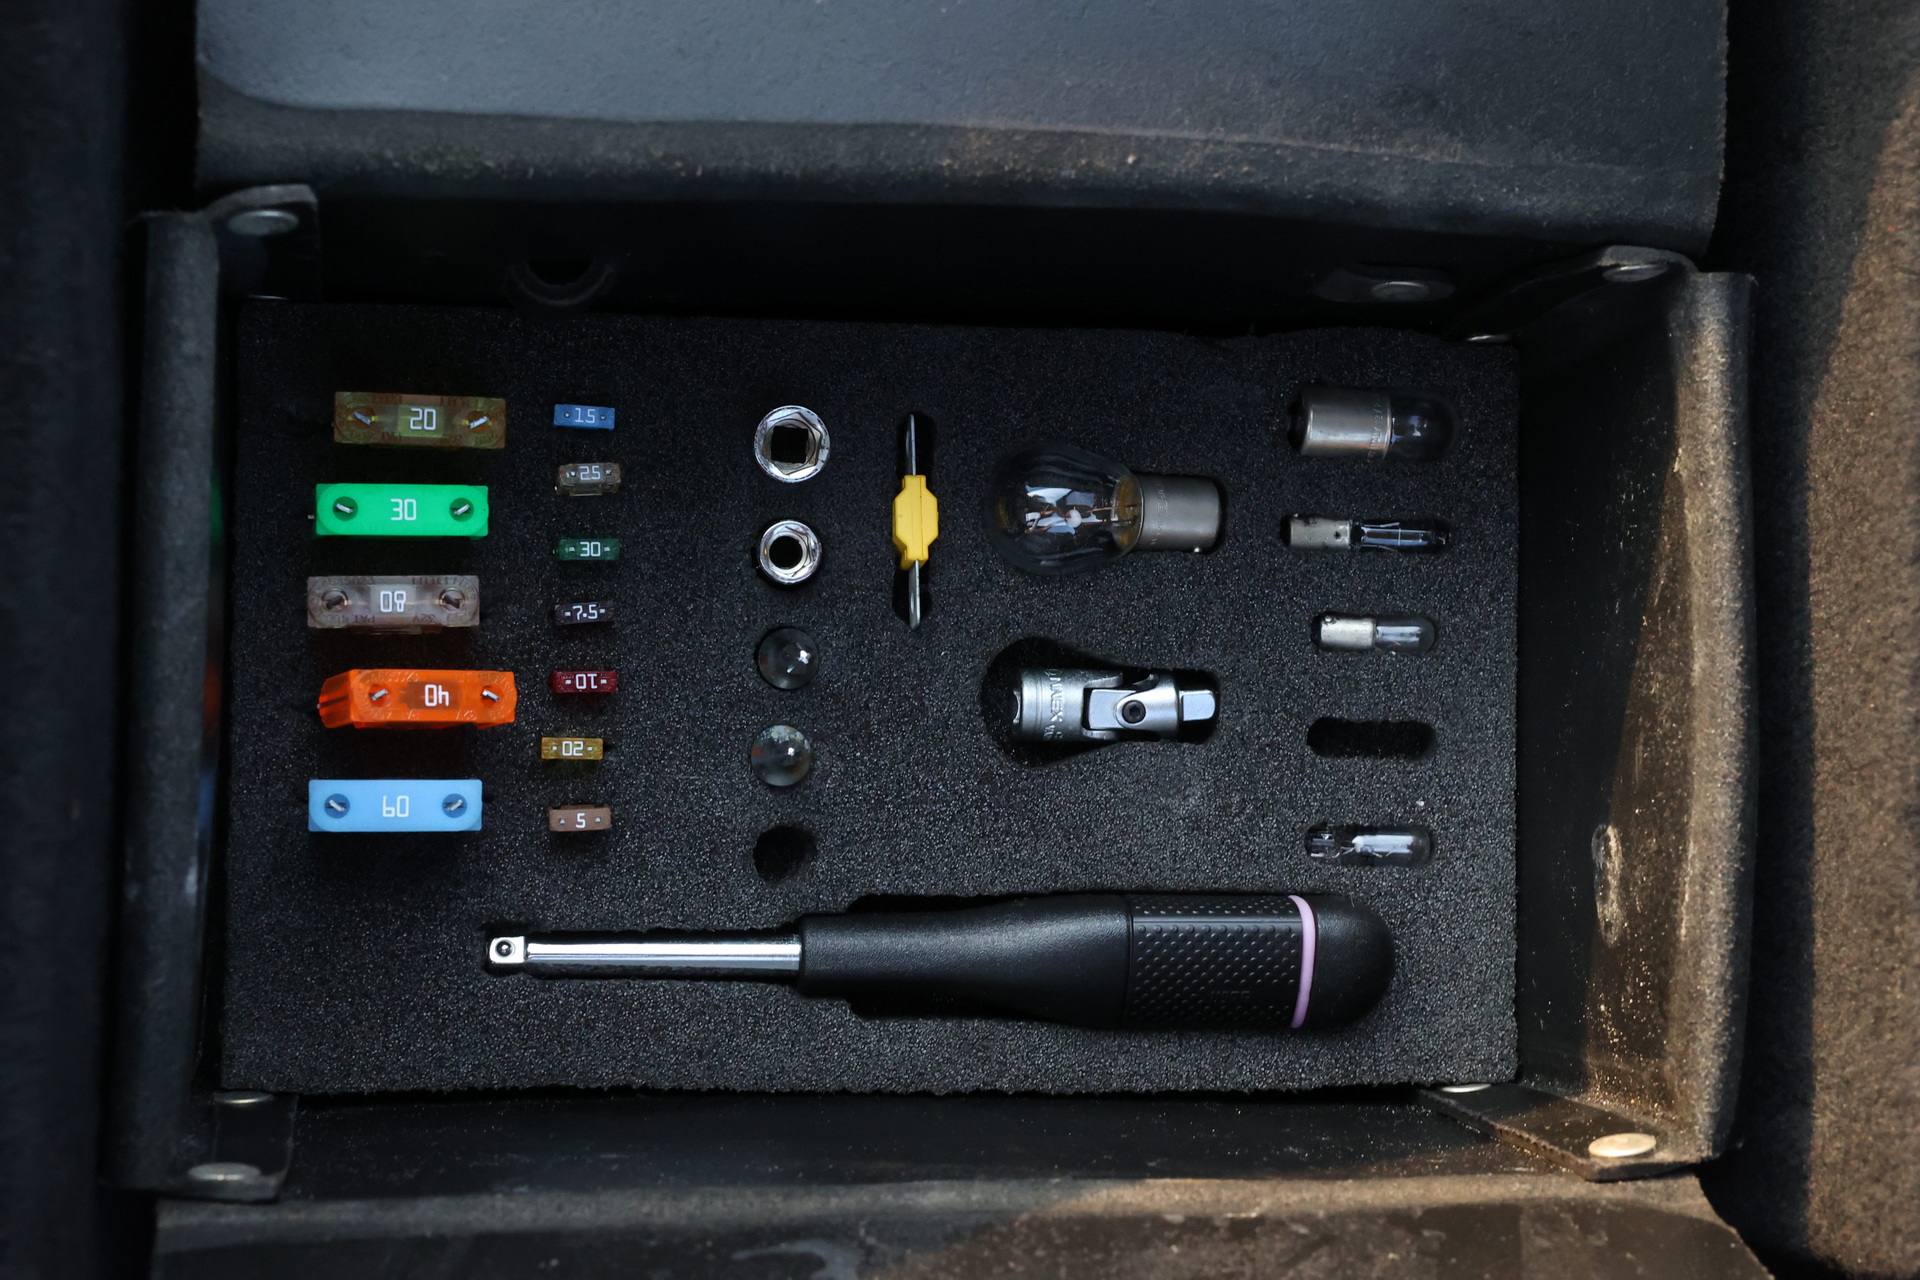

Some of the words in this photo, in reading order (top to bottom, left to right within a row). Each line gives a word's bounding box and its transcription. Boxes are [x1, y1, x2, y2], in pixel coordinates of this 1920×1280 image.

[410, 408, 436, 430] 20
[574, 407, 596, 424] 15
[579, 465, 601, 480] 25
[390, 498, 417, 521] 30
[580, 541, 601, 557] 30
[572, 604, 598, 620] 7.5
[575, 673, 598, 689] 10
[424, 684, 449, 706] 40
[382, 795, 409, 817] 60
[575, 812, 586, 828] 5
